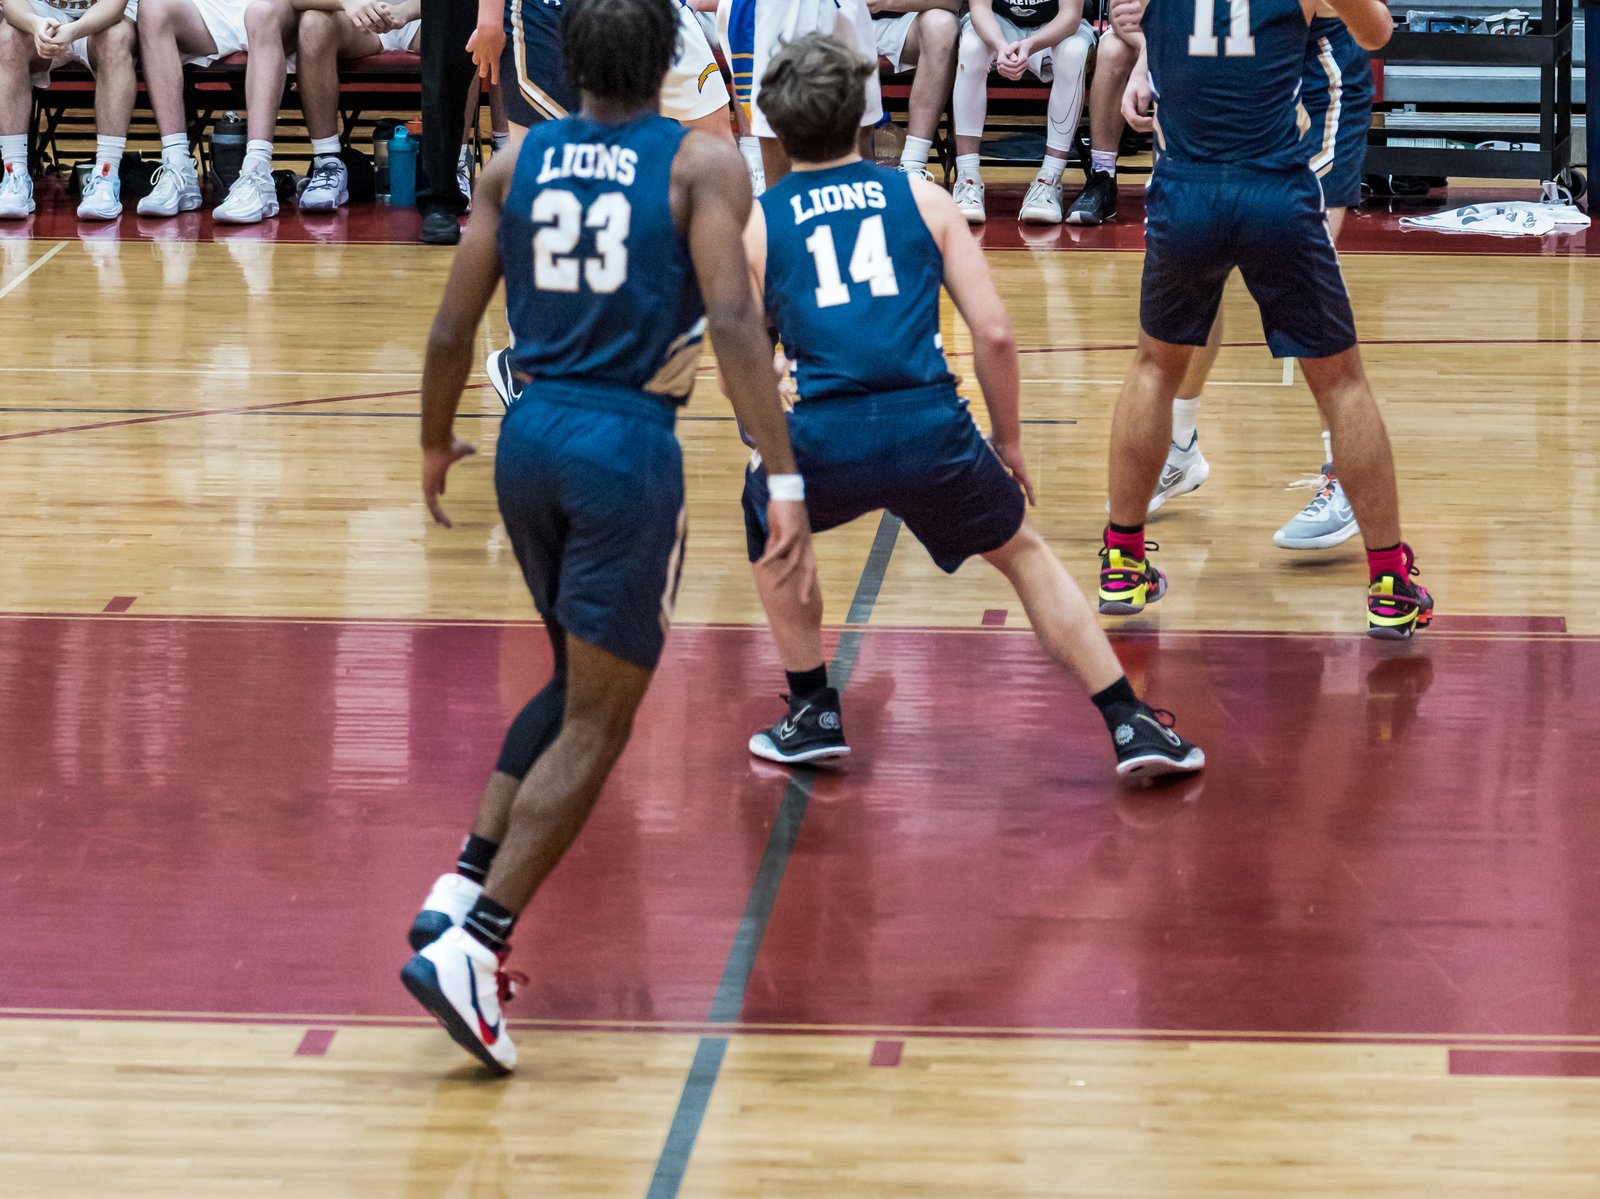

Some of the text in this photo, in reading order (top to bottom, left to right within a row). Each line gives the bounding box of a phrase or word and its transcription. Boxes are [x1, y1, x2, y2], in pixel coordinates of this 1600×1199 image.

[536, 142, 639, 187] LIONS
[790, 180, 887, 226] LIONS
[531, 188, 632, 294] 23
[805, 214, 900, 308] 14
